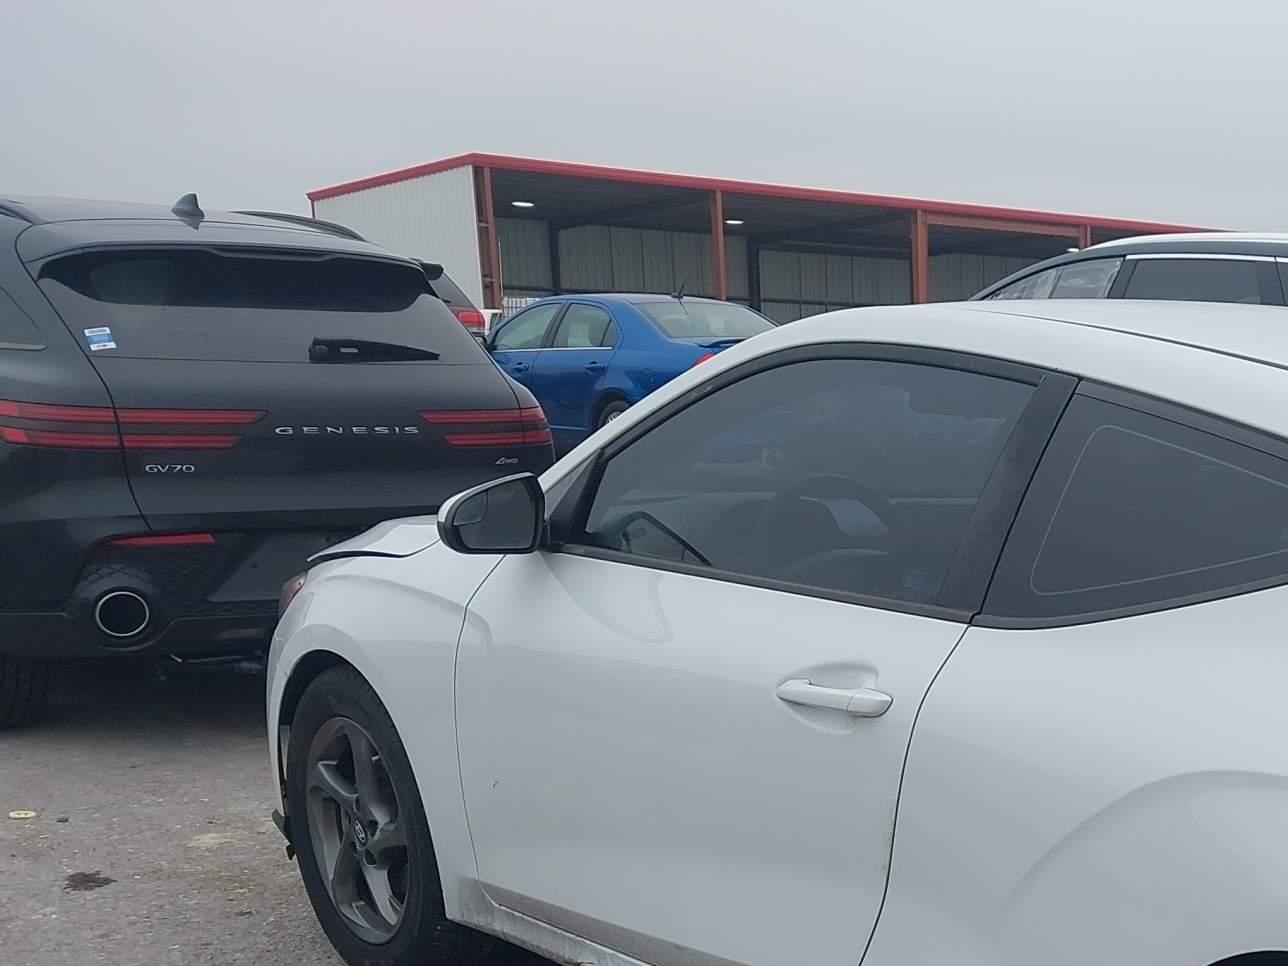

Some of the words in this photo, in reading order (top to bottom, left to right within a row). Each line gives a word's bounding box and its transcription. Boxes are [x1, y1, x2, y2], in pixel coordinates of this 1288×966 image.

[273, 425, 420, 436] GENESIS
[494, 456, 519, 466] AWD
[143, 463, 196, 474] GV70
